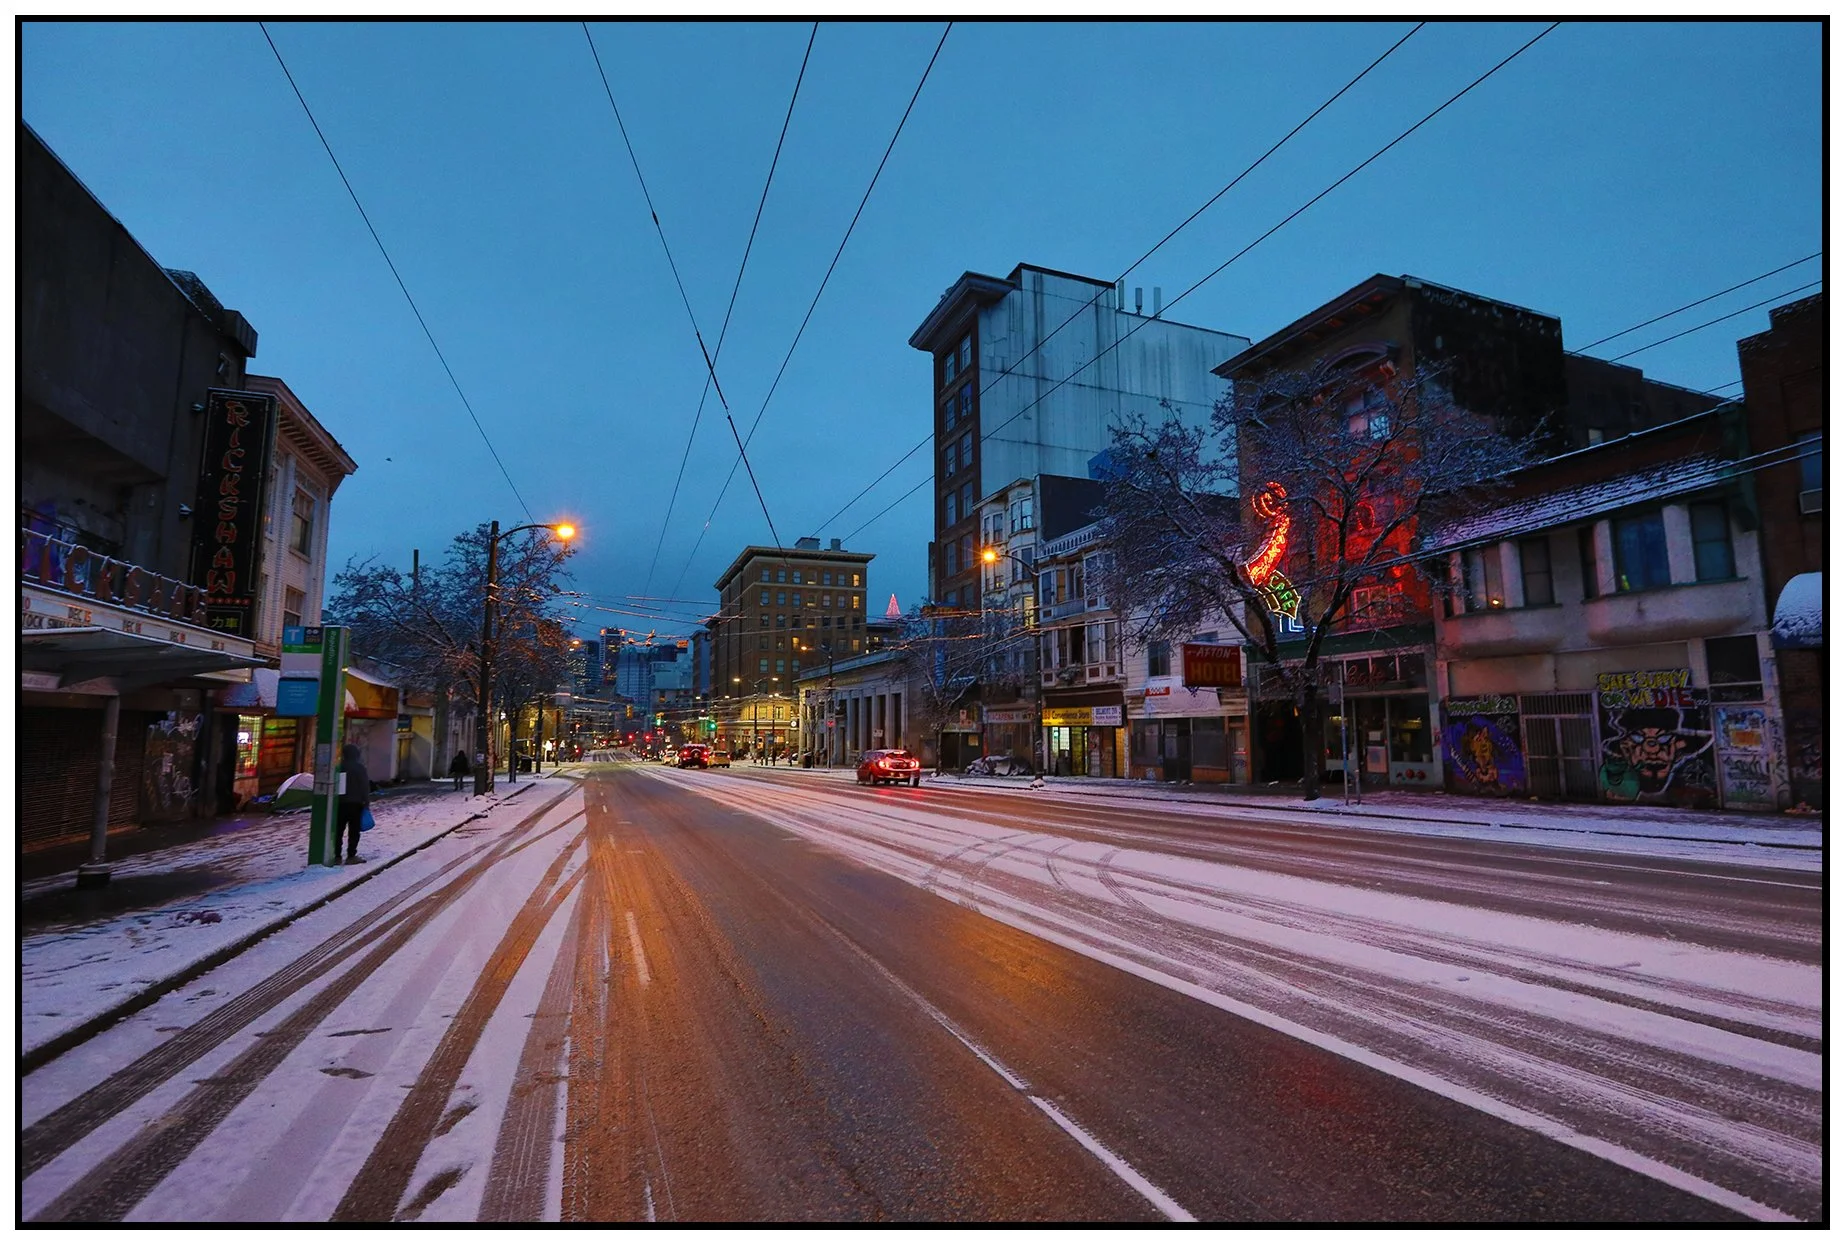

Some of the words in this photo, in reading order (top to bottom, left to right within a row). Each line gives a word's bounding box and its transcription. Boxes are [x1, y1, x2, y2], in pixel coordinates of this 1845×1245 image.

[207, 400, 251, 595] RICKSHAW
[1269, 574, 1297, 612] CAFE
[1196, 647, 1232, 659] AFTON
[1190, 662, 1241, 682] HOTEL
[1598, 672, 1634, 692] SAFE
[1655, 686, 1697, 709] DIE
